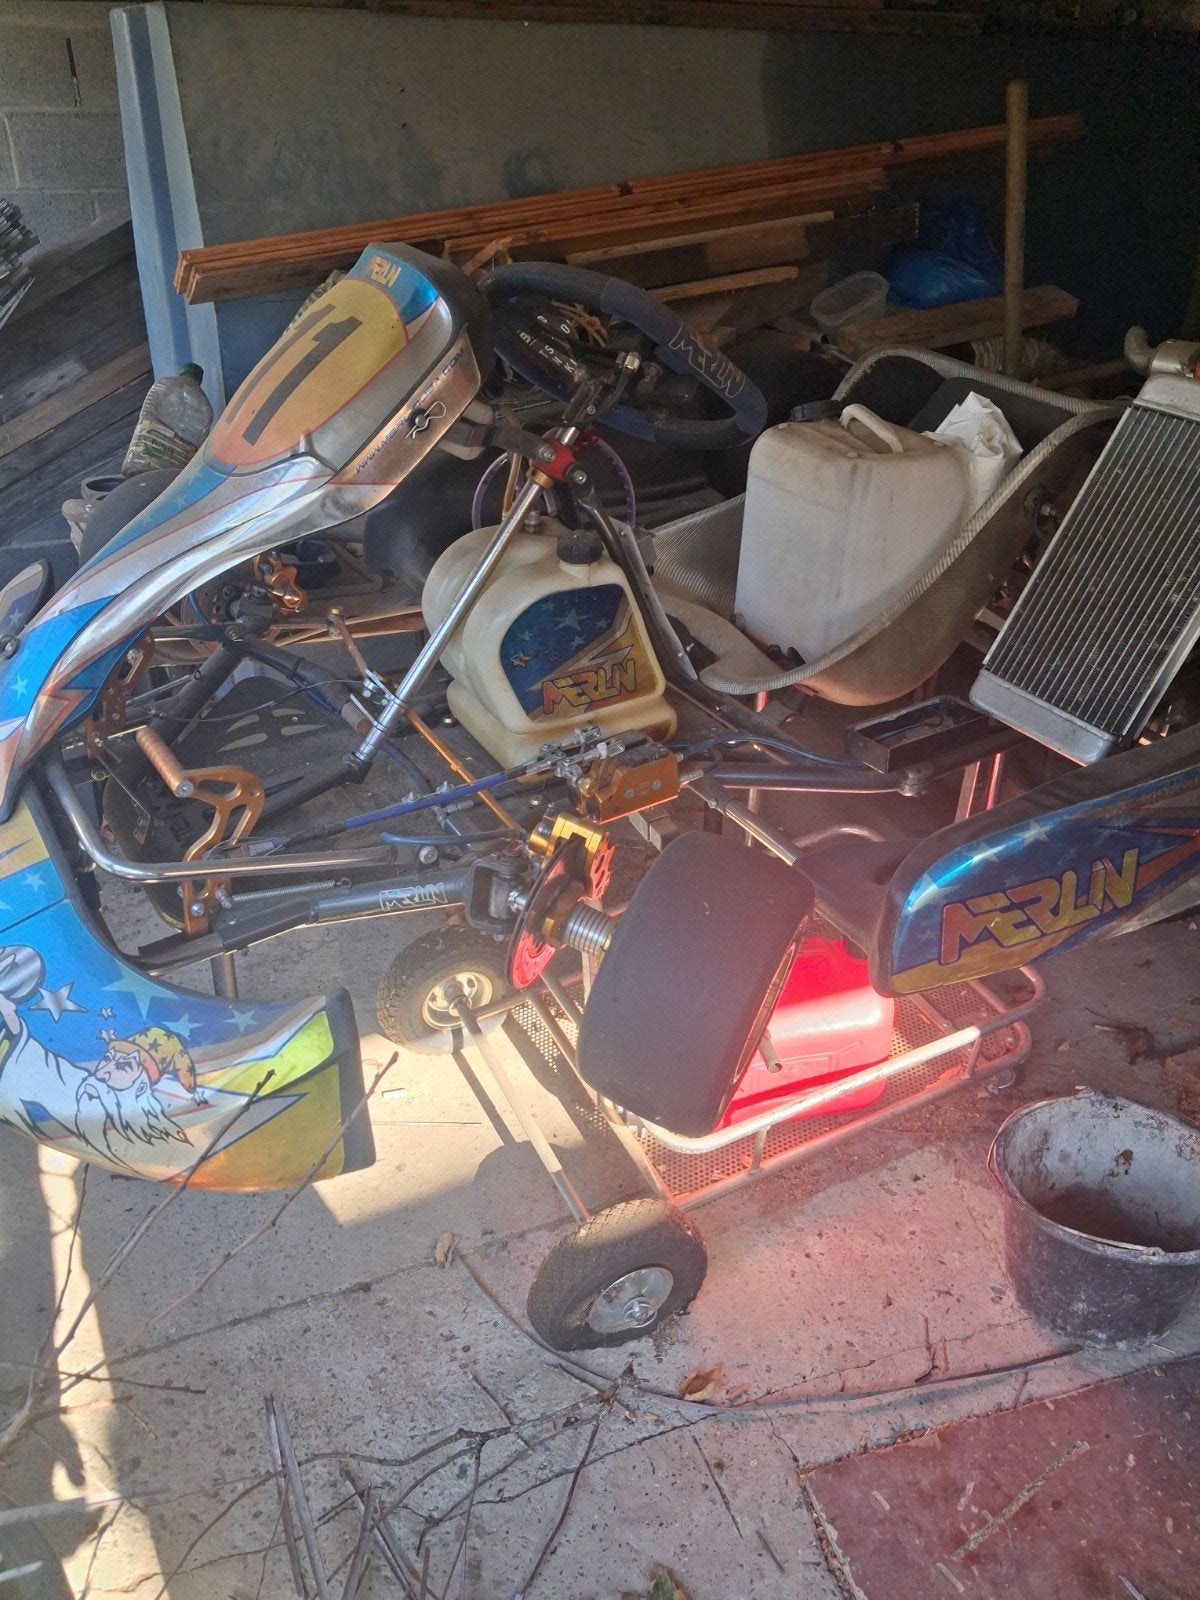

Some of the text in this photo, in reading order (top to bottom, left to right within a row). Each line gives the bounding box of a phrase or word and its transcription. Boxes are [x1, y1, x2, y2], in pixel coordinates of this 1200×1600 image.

[542, 658, 636, 715] MERLIN
[379, 882, 448, 911] MERLIN
[938, 848, 1139, 966] MERLIN
